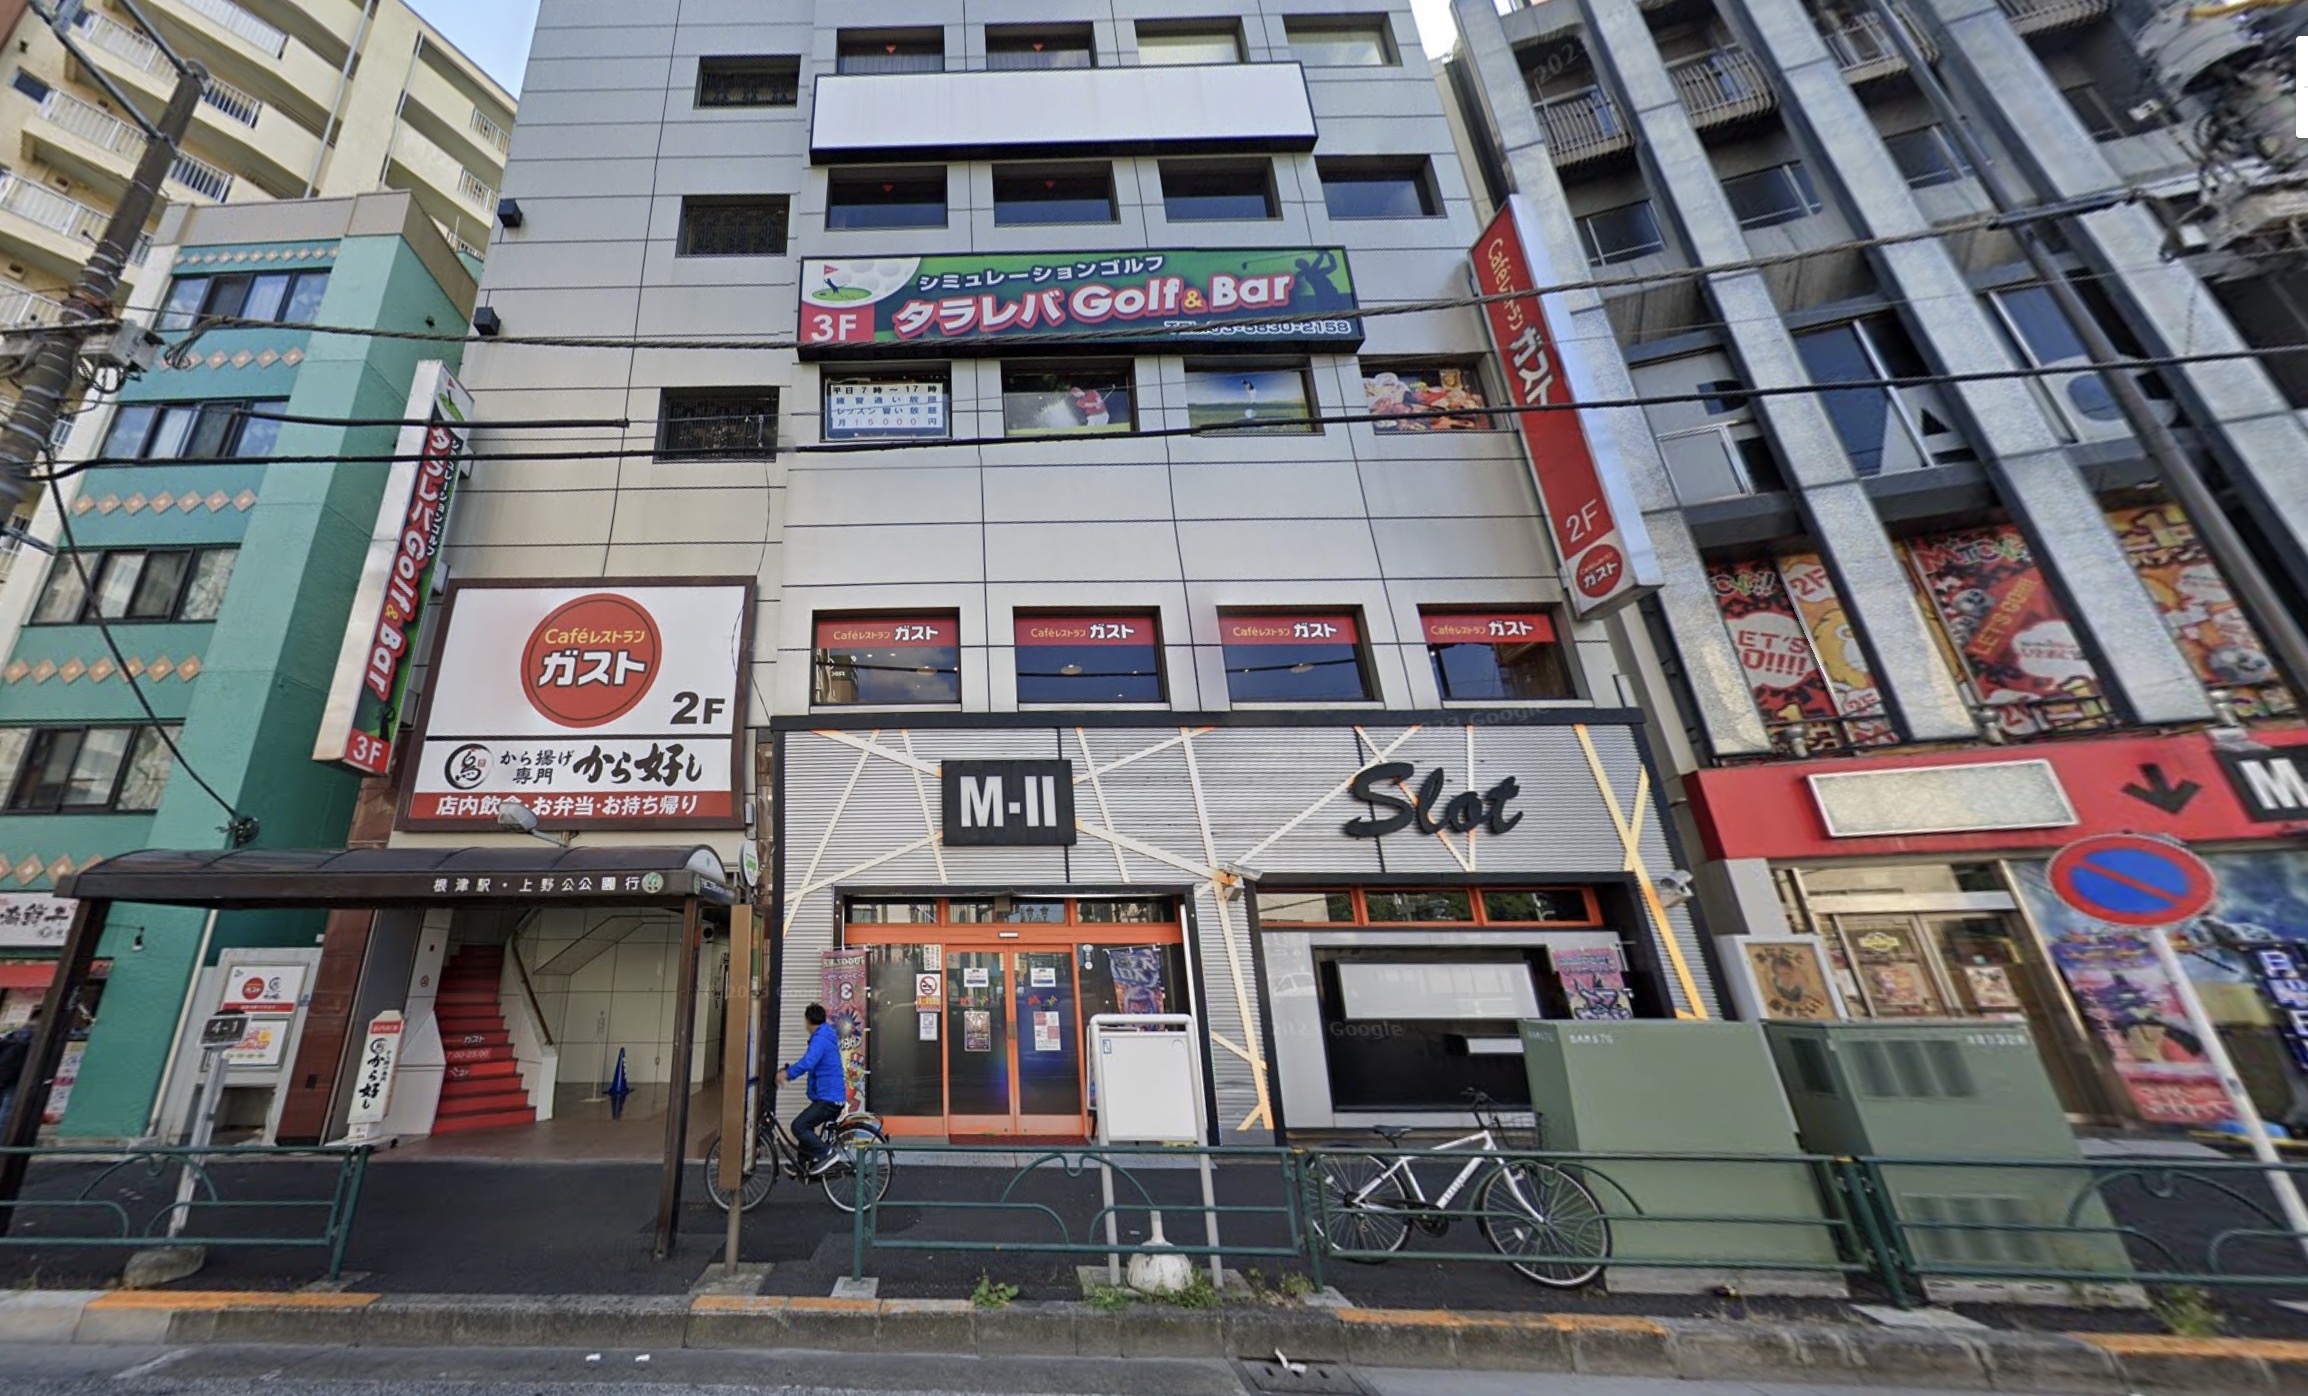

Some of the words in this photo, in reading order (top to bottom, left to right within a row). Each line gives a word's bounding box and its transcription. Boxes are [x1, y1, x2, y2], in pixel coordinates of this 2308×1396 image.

[919, 256, 1163, 291] シミュレーションゴルフ
[898, 289, 1061, 333] タラレバ
[1212, 274, 1292, 307] Bar
[811, 314, 857, 341] 3F
[1509, 325, 1553, 406] ガスト
[1565, 498, 1599, 543] 2F
[1584, 562, 1618, 589] ガスト
[1789, 567, 1827, 597] 2F
[545, 628, 646, 644] Caféレストラン
[833, 629, 890, 641] Caféレストラン
[894, 624, 939, 640] ガスト
[1030, 627, 1086, 639] Caféレストラン
[1089, 623, 1135, 639] ガスト
[1232, 625, 1290, 637] Caféレストラン
[1293, 622, 1337, 639] ガスト
[1430, 624, 1486, 637] Caféレストラン
[1487, 620, 1534, 637] ガスト
[1737, 630, 1808, 653] ET'S
[538, 650, 647, 688] ガスト
[1741, 649, 1809, 676] O!!!!
[670, 691, 726, 725] 2F
[353, 735, 383, 765] 3F
[500, 749, 575, 766] から揚げ
[512, 767, 553, 785] 専門
[572, 742, 703, 786] から好し
[1345, 761, 1524, 837] Slot
[211, 1020, 239, 1034] 4-1
[358, 1055, 385, 1110] から好し
